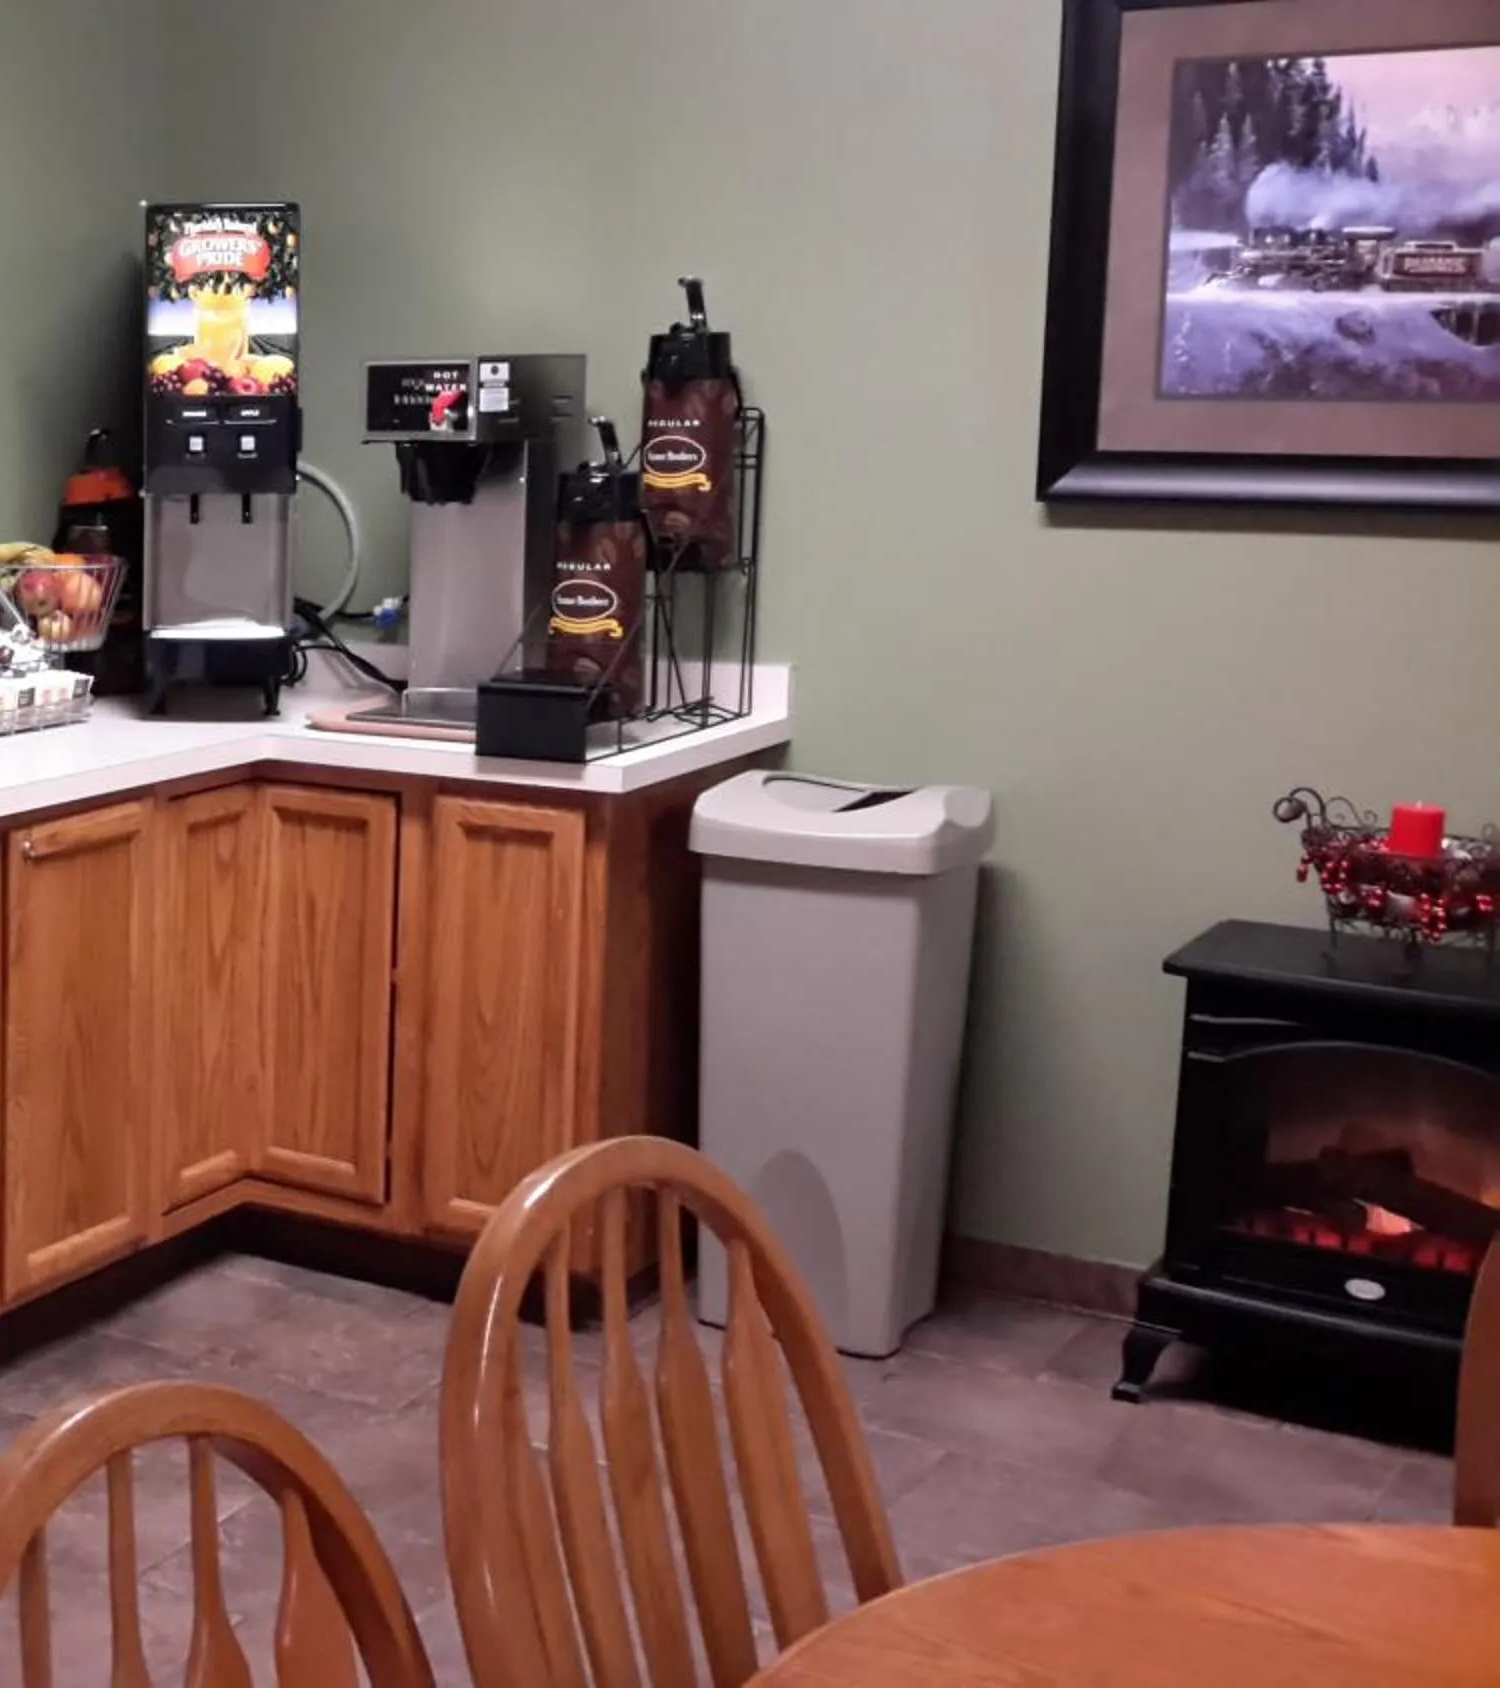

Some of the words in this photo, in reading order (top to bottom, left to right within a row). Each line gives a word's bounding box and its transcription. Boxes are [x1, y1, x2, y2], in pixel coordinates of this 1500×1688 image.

[195, 250, 246, 267] PRIDE
[433, 371, 459, 380] HOT
[425, 383, 468, 393] WATER
